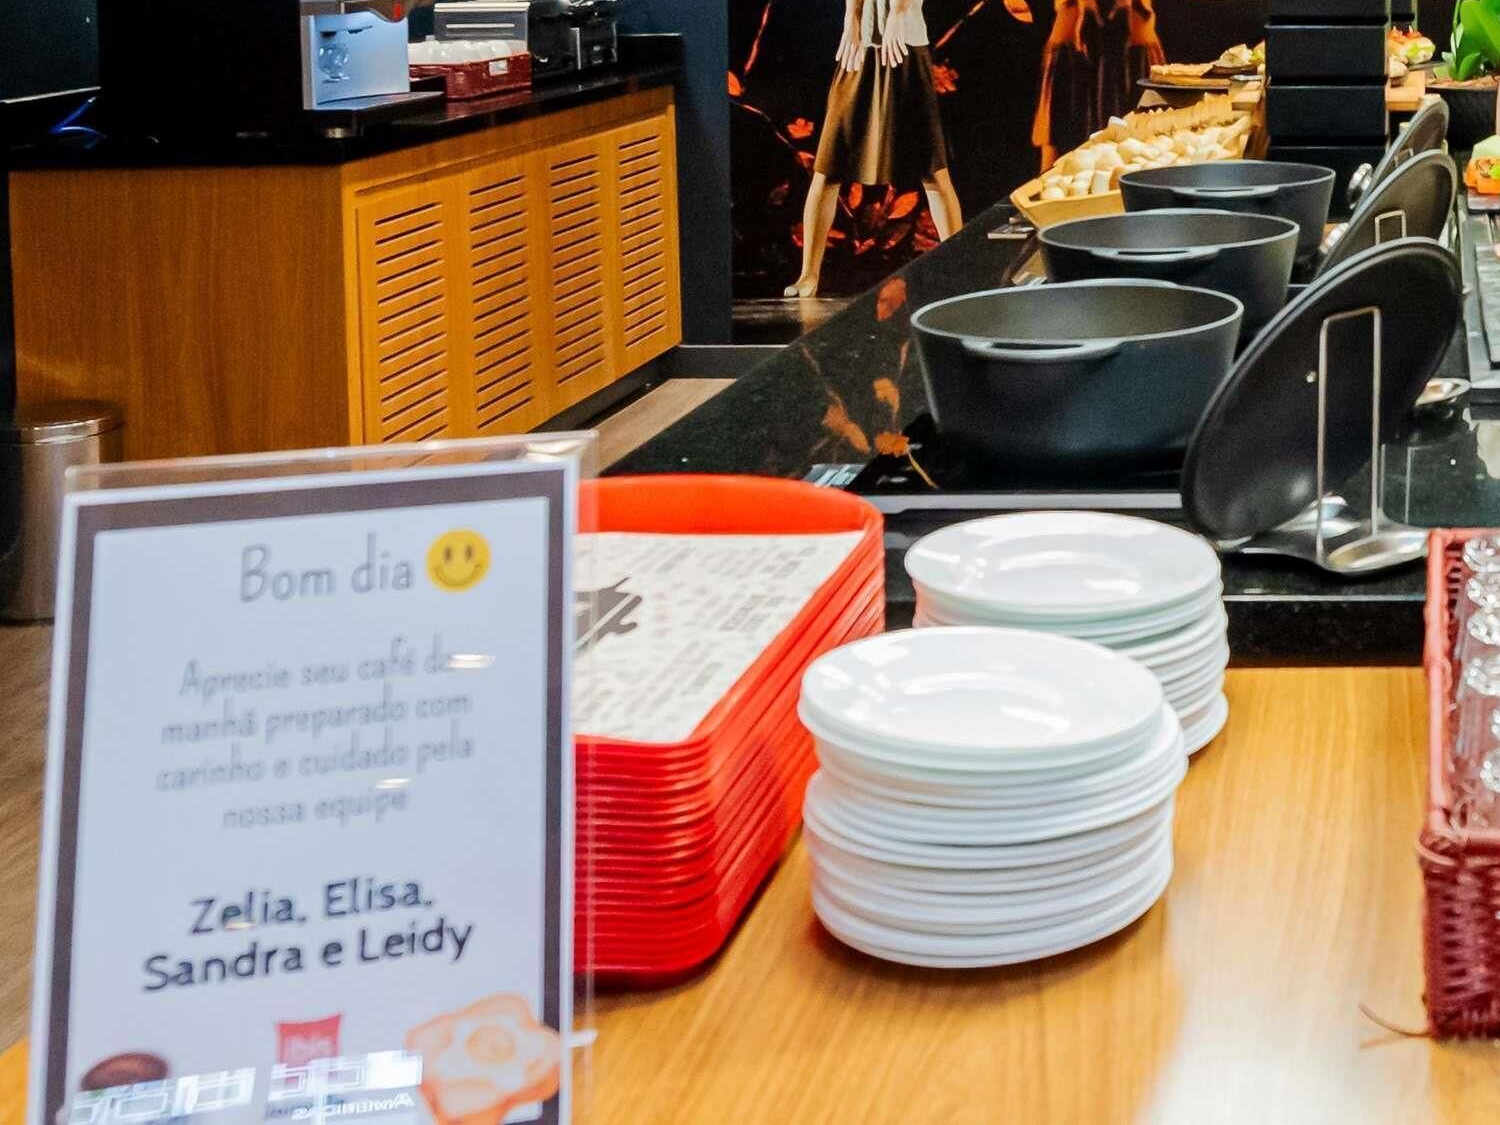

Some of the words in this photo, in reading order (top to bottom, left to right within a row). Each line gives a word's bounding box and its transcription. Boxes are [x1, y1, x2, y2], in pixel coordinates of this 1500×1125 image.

[239, 543, 337, 603] Bom
[351, 531, 415, 593] dia
[179, 658, 290, 706] Aprecie
[300, 663, 349, 687] seu
[357, 635, 416, 681] café
[265, 683, 409, 746] preparado
[415, 693, 473, 719] com
[155, 741, 265, 792] carinho
[273, 757, 290, 779] e
[298, 725, 409, 776] cuidado
[417, 719, 475, 774] pela
[222, 800, 305, 829] nossa
[314, 788, 409, 828] equipe
[143, 941, 304, 992] Sandra
[321, 939, 344, 967] e
[359, 917, 475, 962] Leidy
